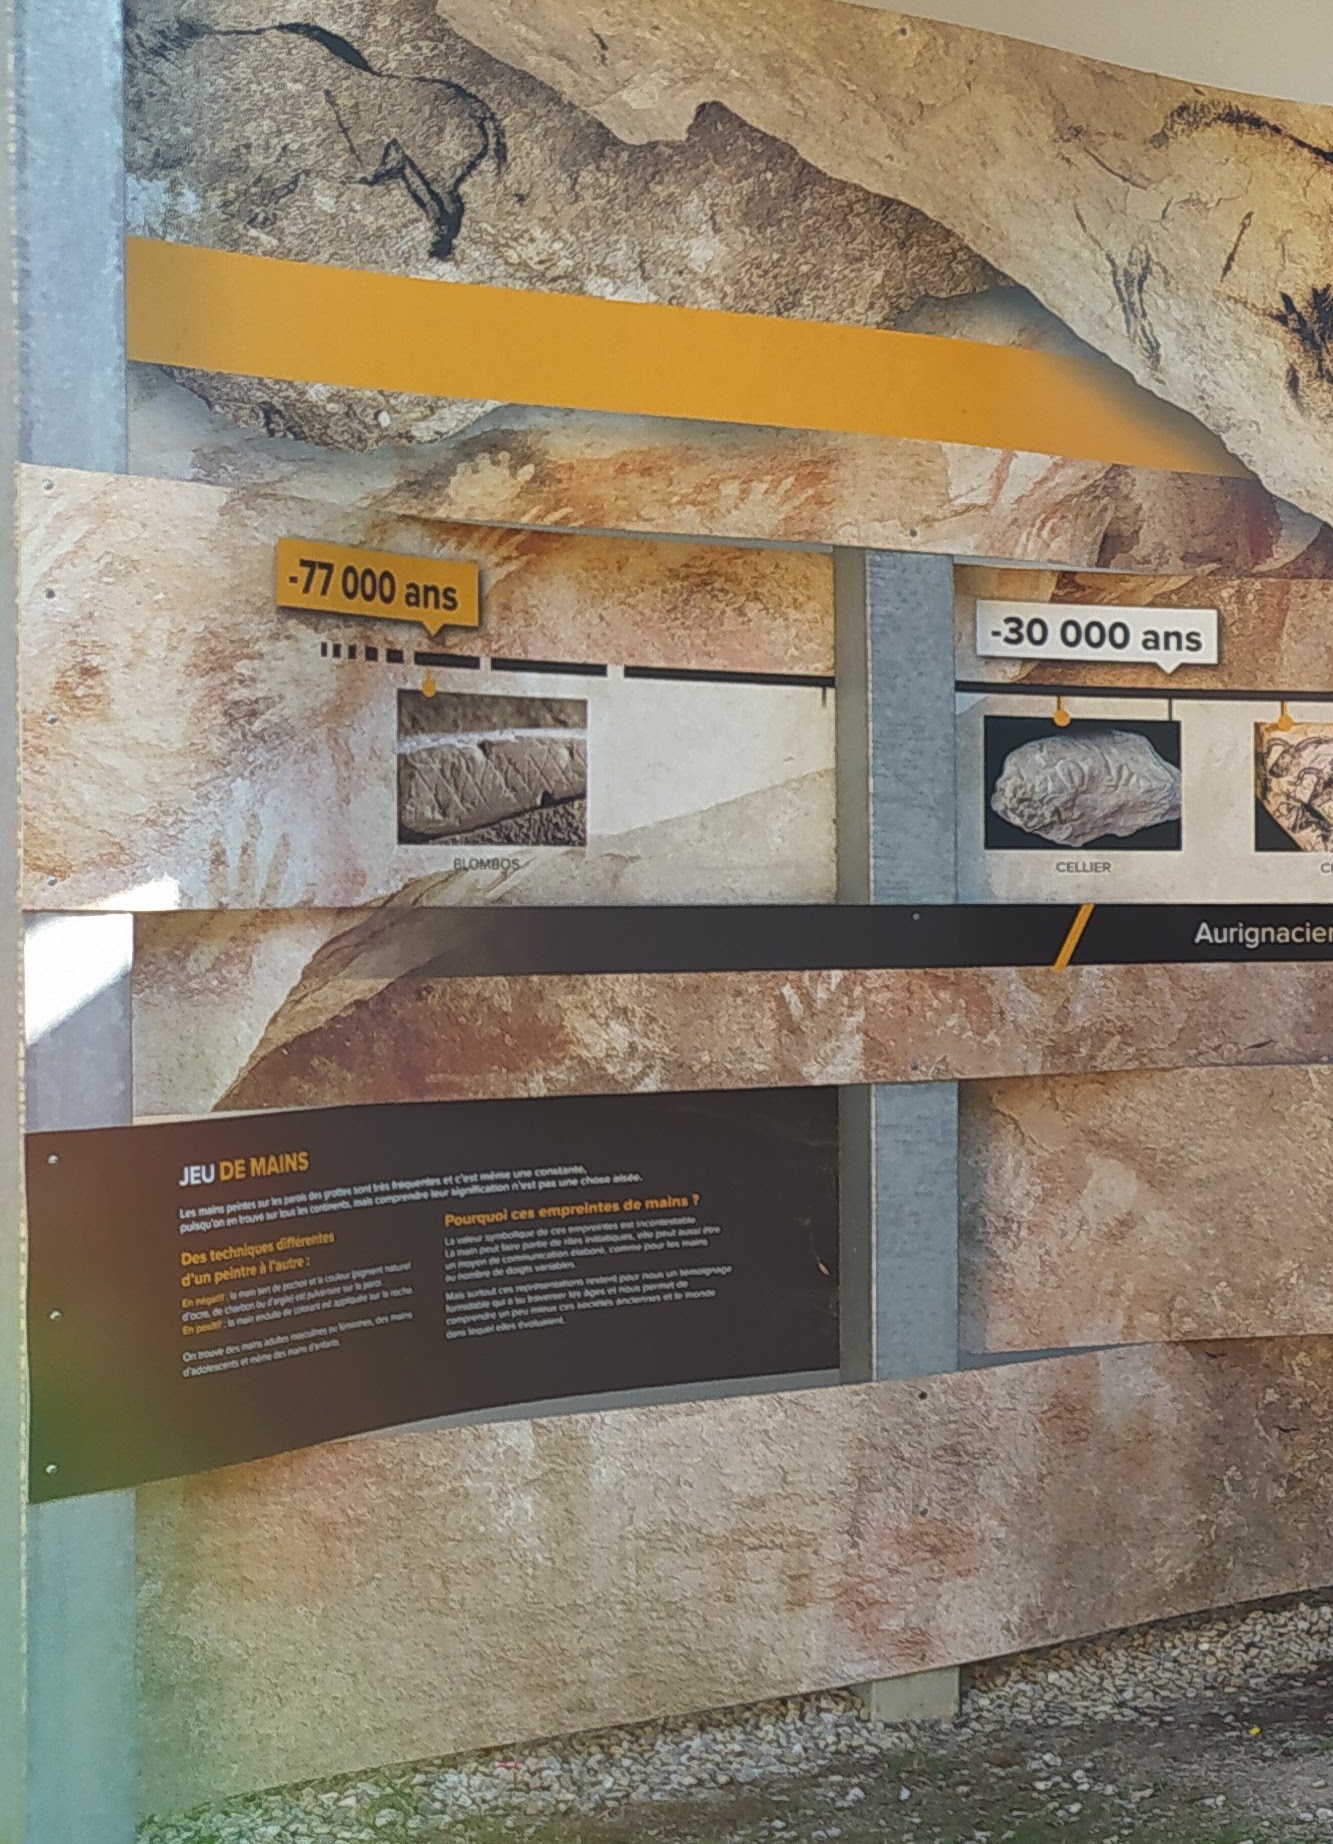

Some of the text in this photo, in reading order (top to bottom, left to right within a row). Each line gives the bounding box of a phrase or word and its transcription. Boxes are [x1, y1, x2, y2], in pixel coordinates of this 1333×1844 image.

[288, 559, 459, 612] -77 000 ans
[991, 616, 1203, 653] -30 000 ans
[453, 857, 520, 871] BLOMBOS
[1055, 861, 1112, 874] CELLIER
[179, 1151, 308, 1186] JEU DE MAINS
[444, 1194, 699, 1227] Pourquoi ces empreintes de mains ?
[209, 1242, 274, 1262] techniques
